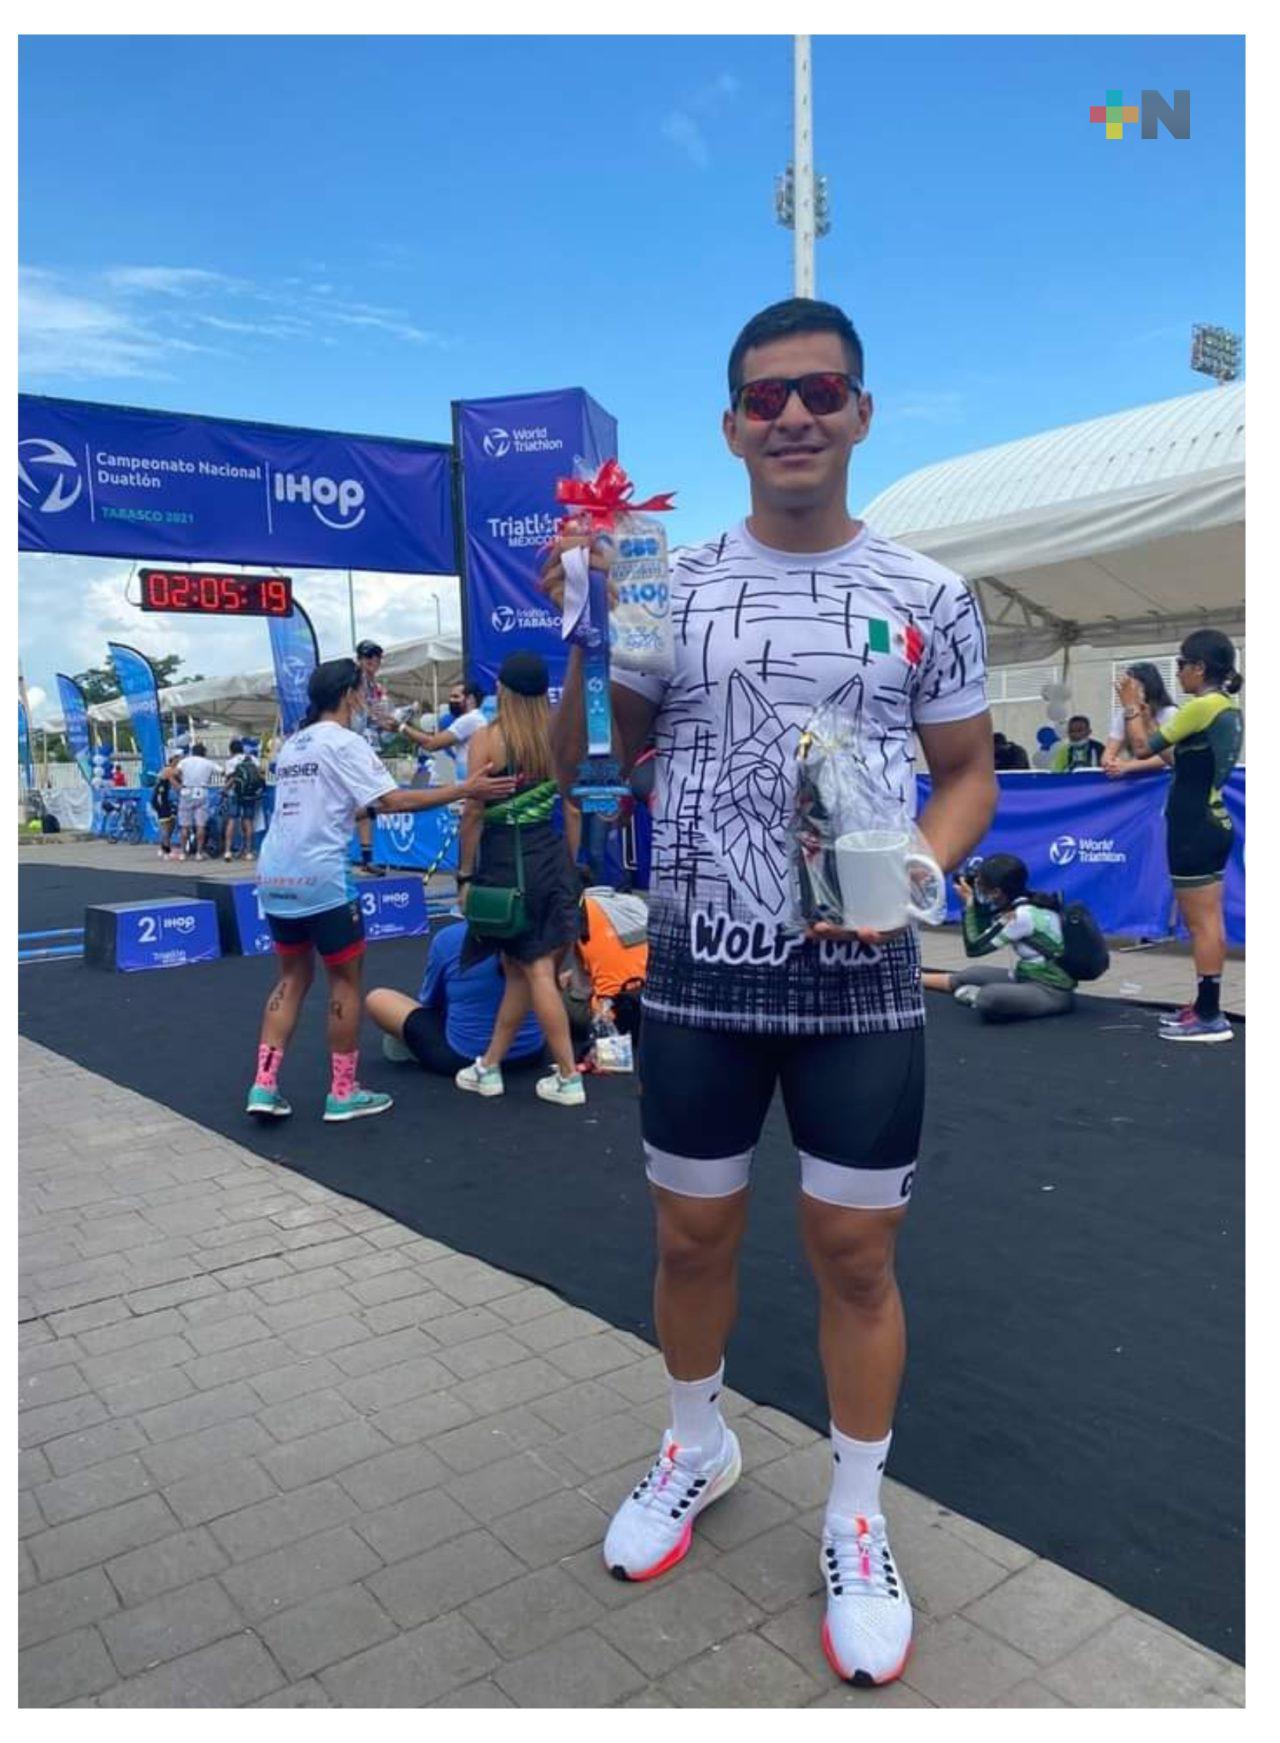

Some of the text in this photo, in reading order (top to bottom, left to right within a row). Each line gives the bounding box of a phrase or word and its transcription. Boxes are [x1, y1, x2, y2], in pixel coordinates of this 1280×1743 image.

[512, 427, 548, 440] World
[513, 438, 563, 453] Triathlon
[95, 452, 262, 480] Campeonato Nacional
[97, 468, 162, 489] Duatlón
[101, 508, 195, 525] TABASCO 2021
[148, 575, 288, 612] 02:05:19
[517, 616, 562, 628] TABASC
[361, 892, 376, 916] 3
[137, 916, 158, 943] 2
[692, 911, 805, 966] WOLF
